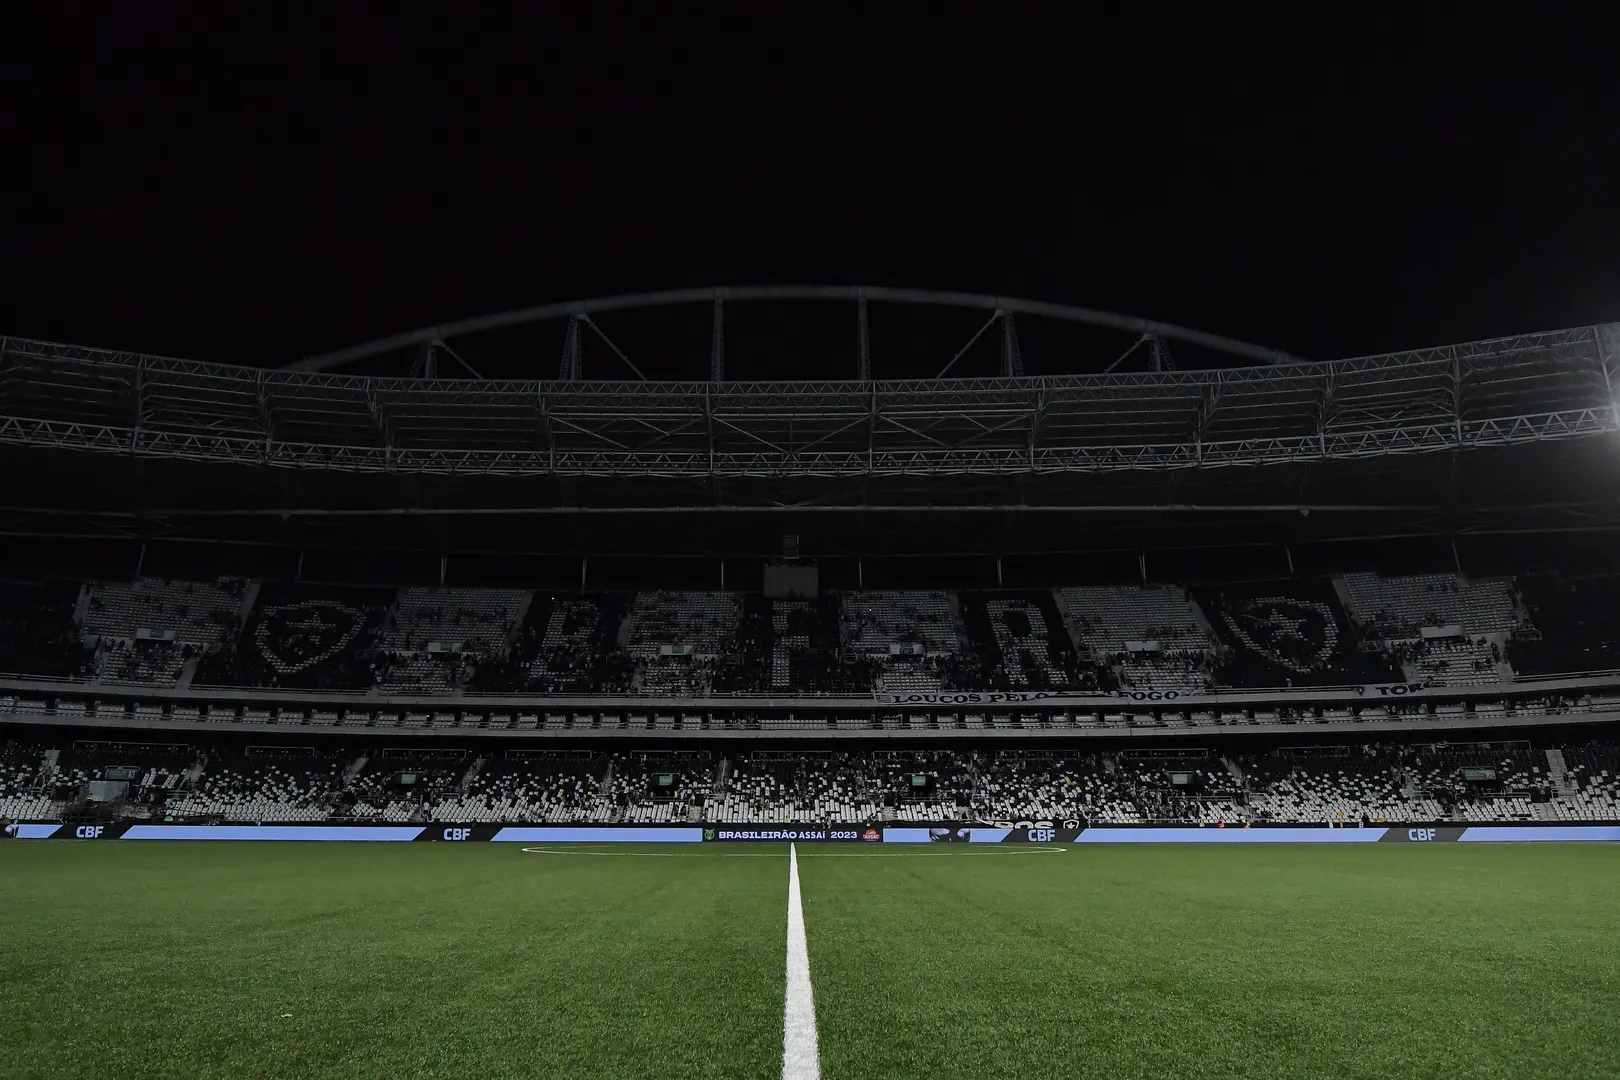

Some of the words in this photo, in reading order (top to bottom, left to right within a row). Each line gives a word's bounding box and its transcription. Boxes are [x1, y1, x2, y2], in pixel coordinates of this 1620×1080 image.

[893, 693, 982, 704] LOUCOS
[988, 692, 1048, 703] PELO
[75, 825, 104, 838] CBF
[443, 828, 471, 840] CBF
[718, 829, 798, 839] BRASILEIRÃO
[798, 830, 826, 839] ASSAÍ
[830, 831, 858, 839] 2023
[1027, 829, 1056, 842] CBF
[1408, 828, 1436, 841] CBF
